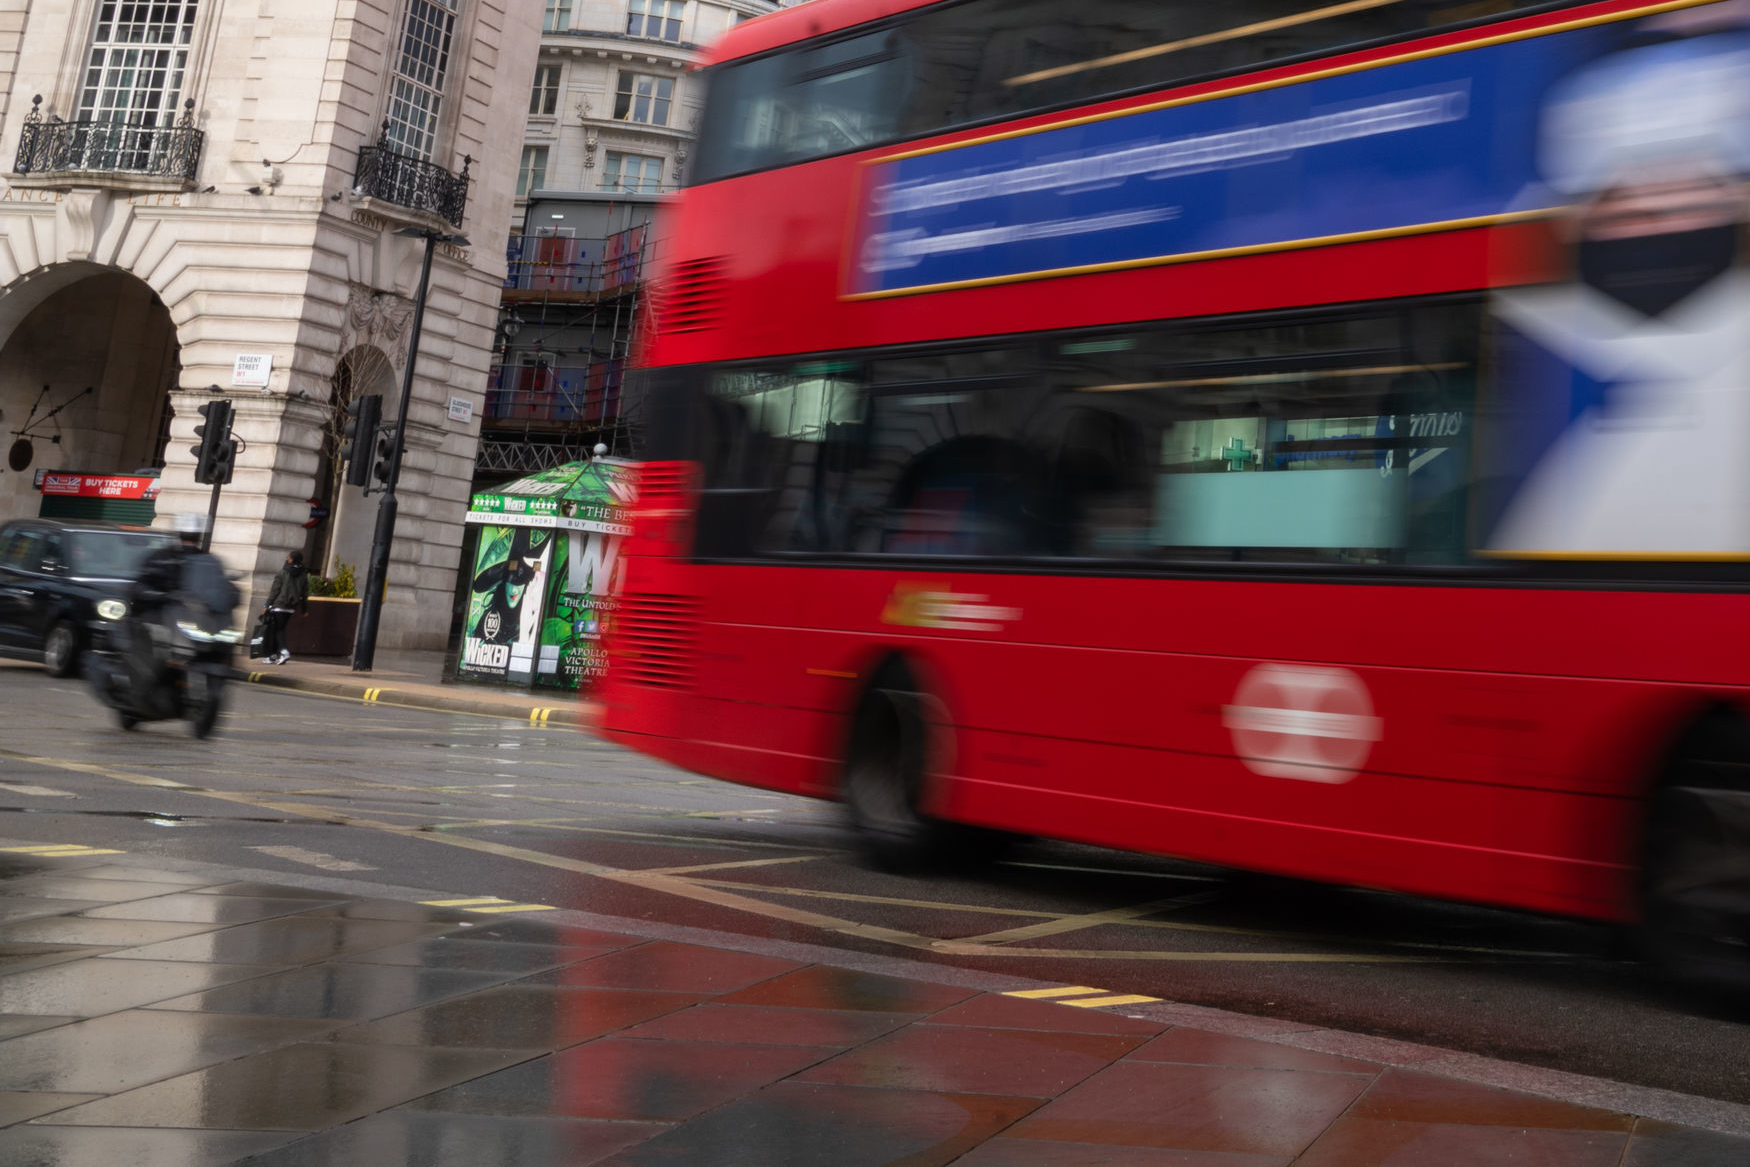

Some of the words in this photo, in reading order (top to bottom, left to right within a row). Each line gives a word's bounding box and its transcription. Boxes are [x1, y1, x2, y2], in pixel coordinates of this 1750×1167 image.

[127, 192, 182, 207] LIFE
[350, 208, 388, 231] COUNTY
[239, 355, 262, 363] REGENT
[85, 478, 103, 486] BUY
[104, 480, 138, 488] TICKETS
[99, 487, 121, 495] HERE
[564, 598, 580, 607] THE
[582, 599, 615, 610] UNTOLD
[571, 647, 608, 657] APOLLO
[565, 657, 610, 667] VICTORIA
[565, 666, 608, 676] THEATRE
